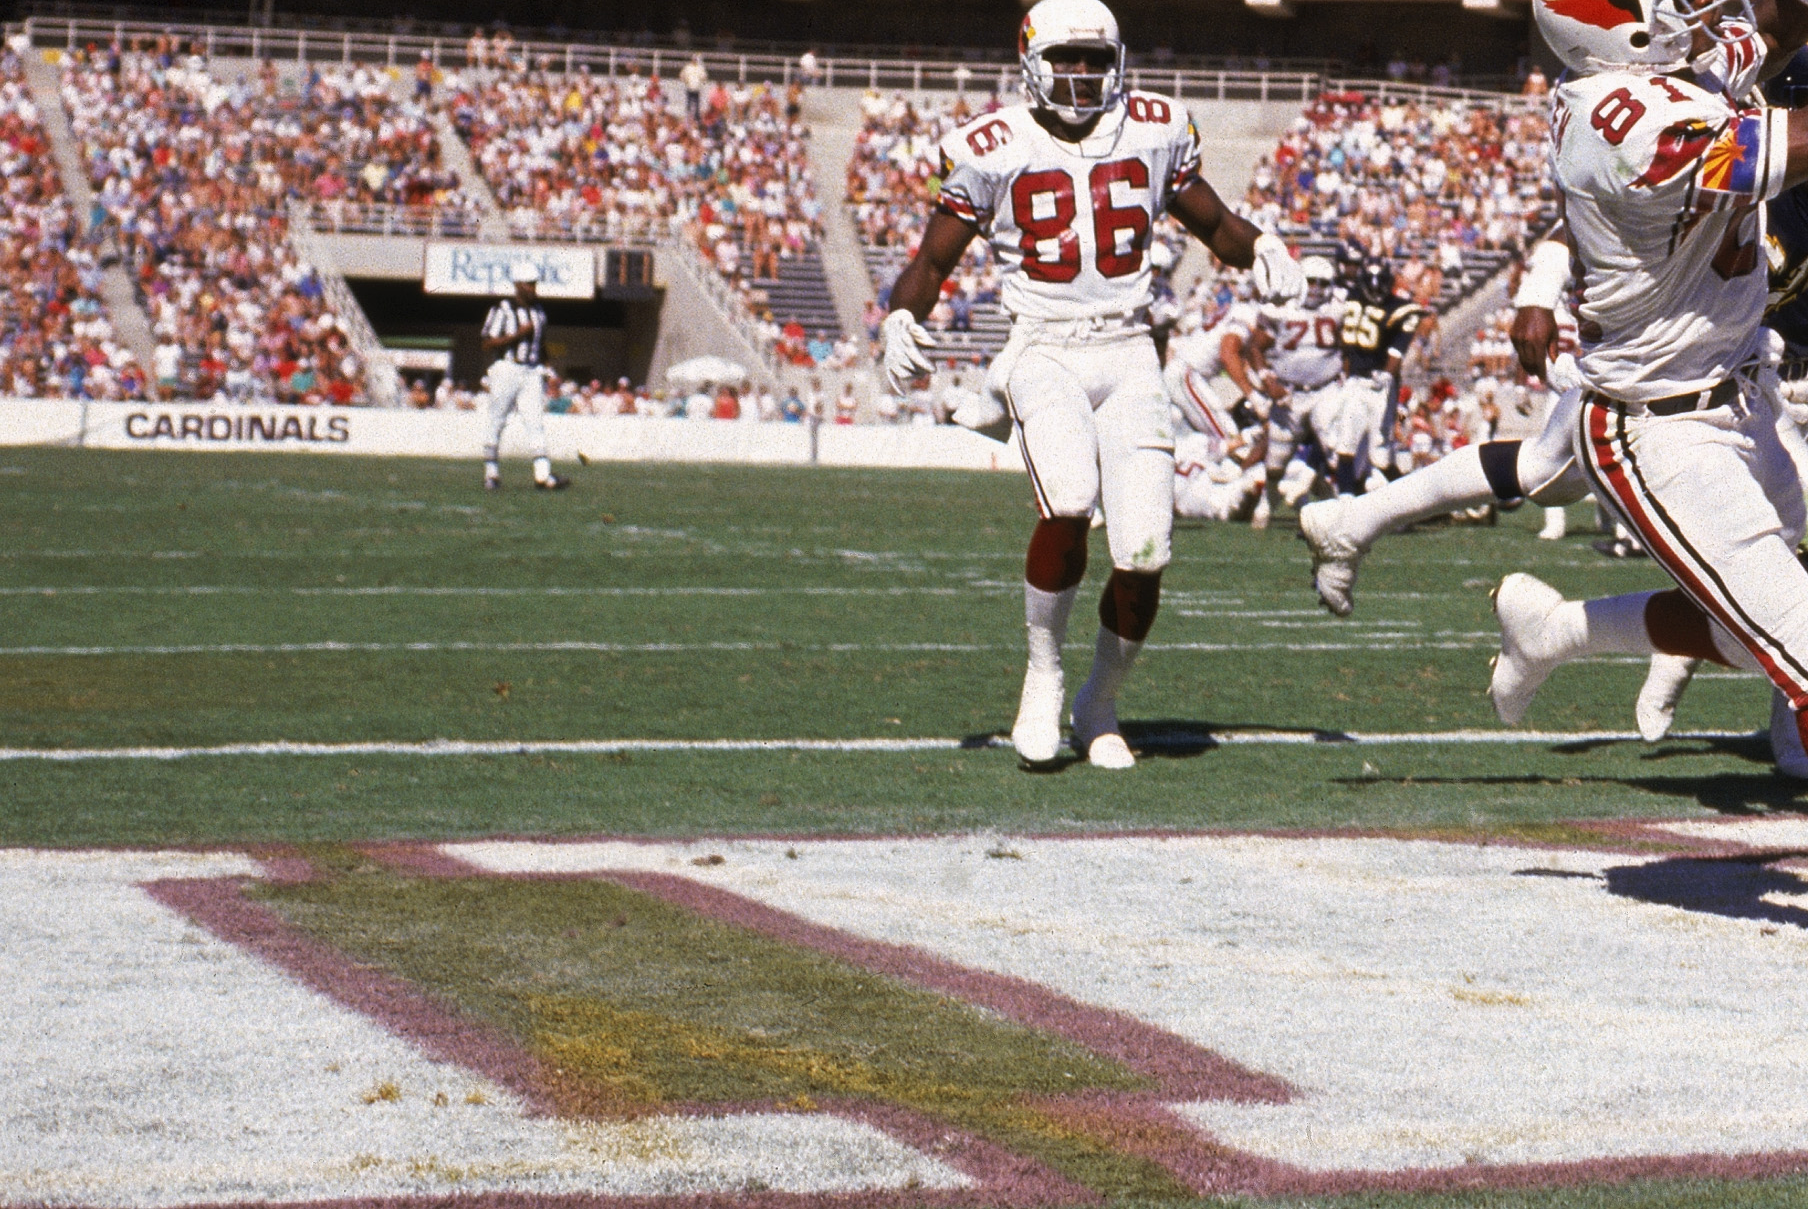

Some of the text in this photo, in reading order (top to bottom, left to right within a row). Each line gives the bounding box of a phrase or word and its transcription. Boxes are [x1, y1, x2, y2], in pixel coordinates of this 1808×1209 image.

[1590, 76, 1693, 147] 81
[1010, 156, 1150, 284] 86
[125, 412, 350, 442] CARDINALS
